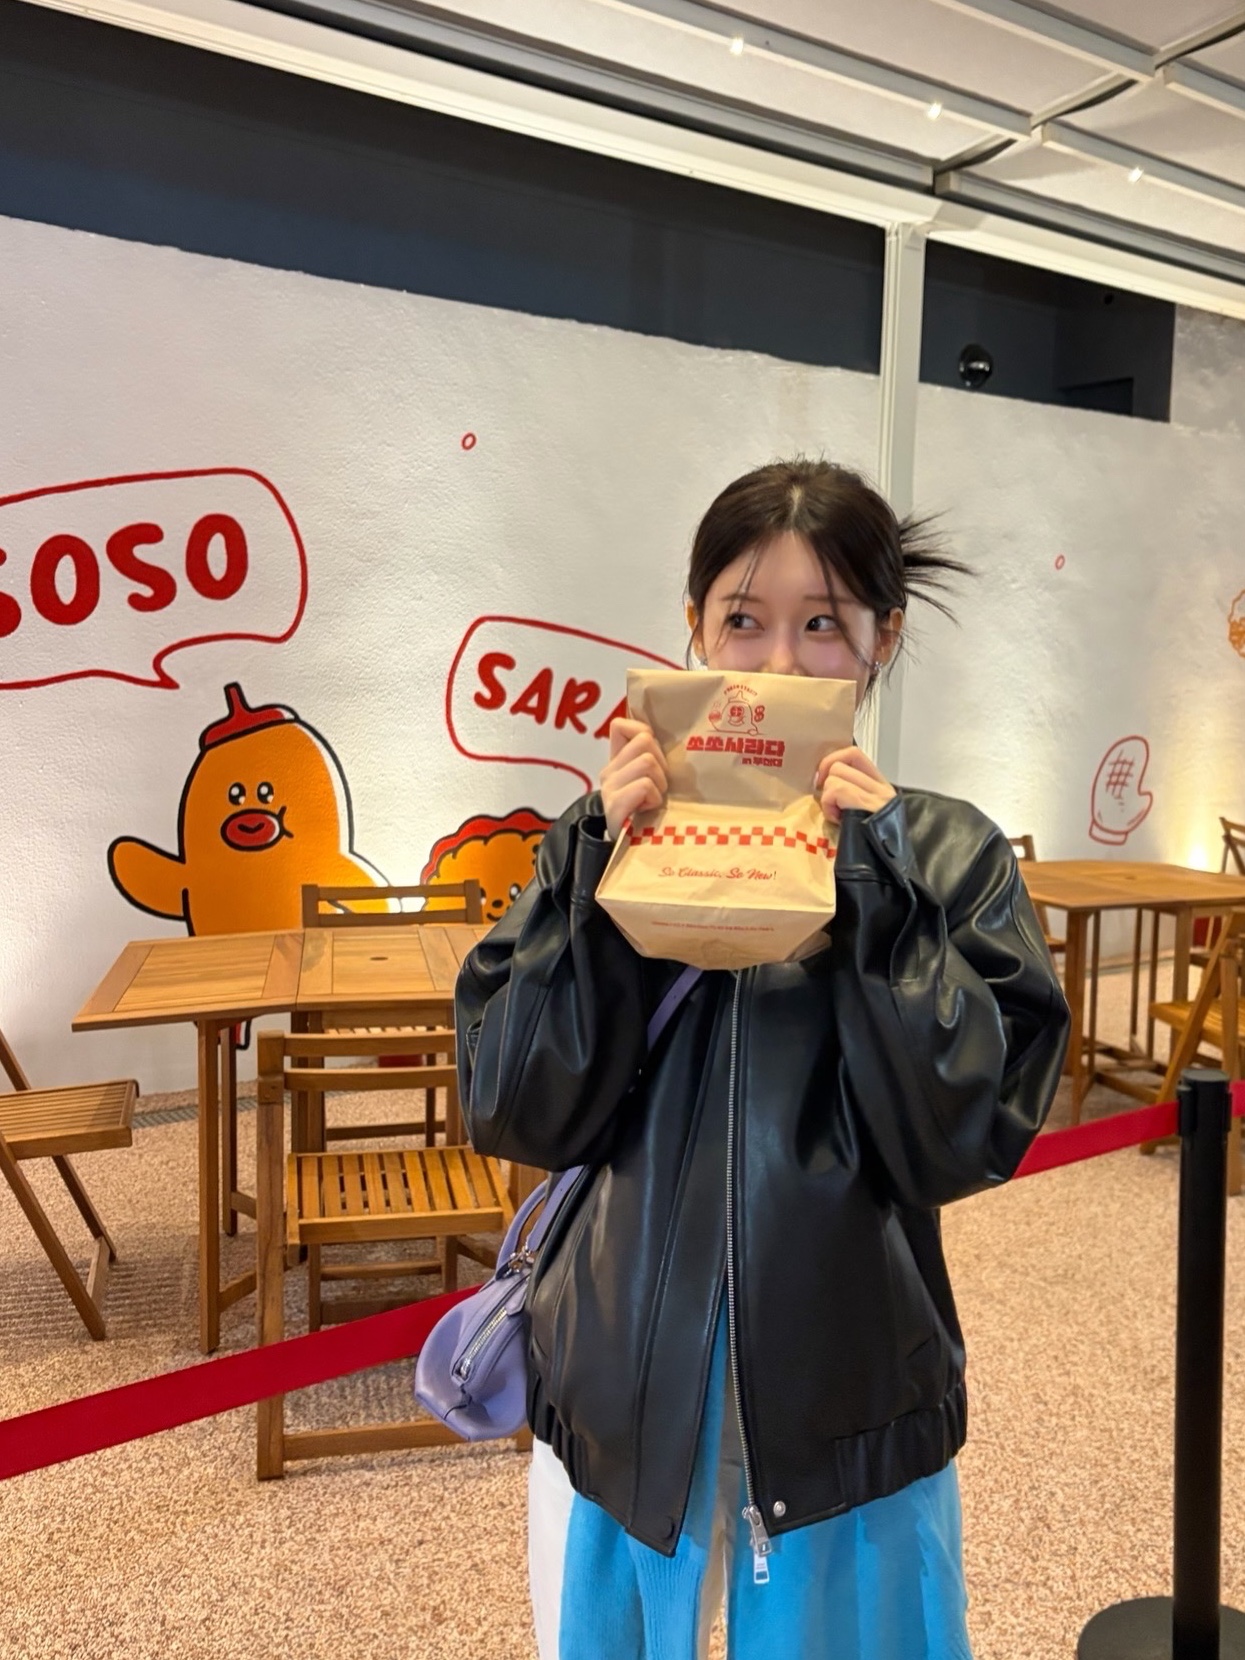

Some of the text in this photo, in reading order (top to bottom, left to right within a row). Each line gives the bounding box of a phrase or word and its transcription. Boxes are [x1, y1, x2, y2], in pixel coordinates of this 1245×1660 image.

[686, 735, 785, 757] 쏘쏘사라다
[658, 866, 675, 878] So
[726, 867, 744, 879] So
[747, 868, 777, 881] New!
